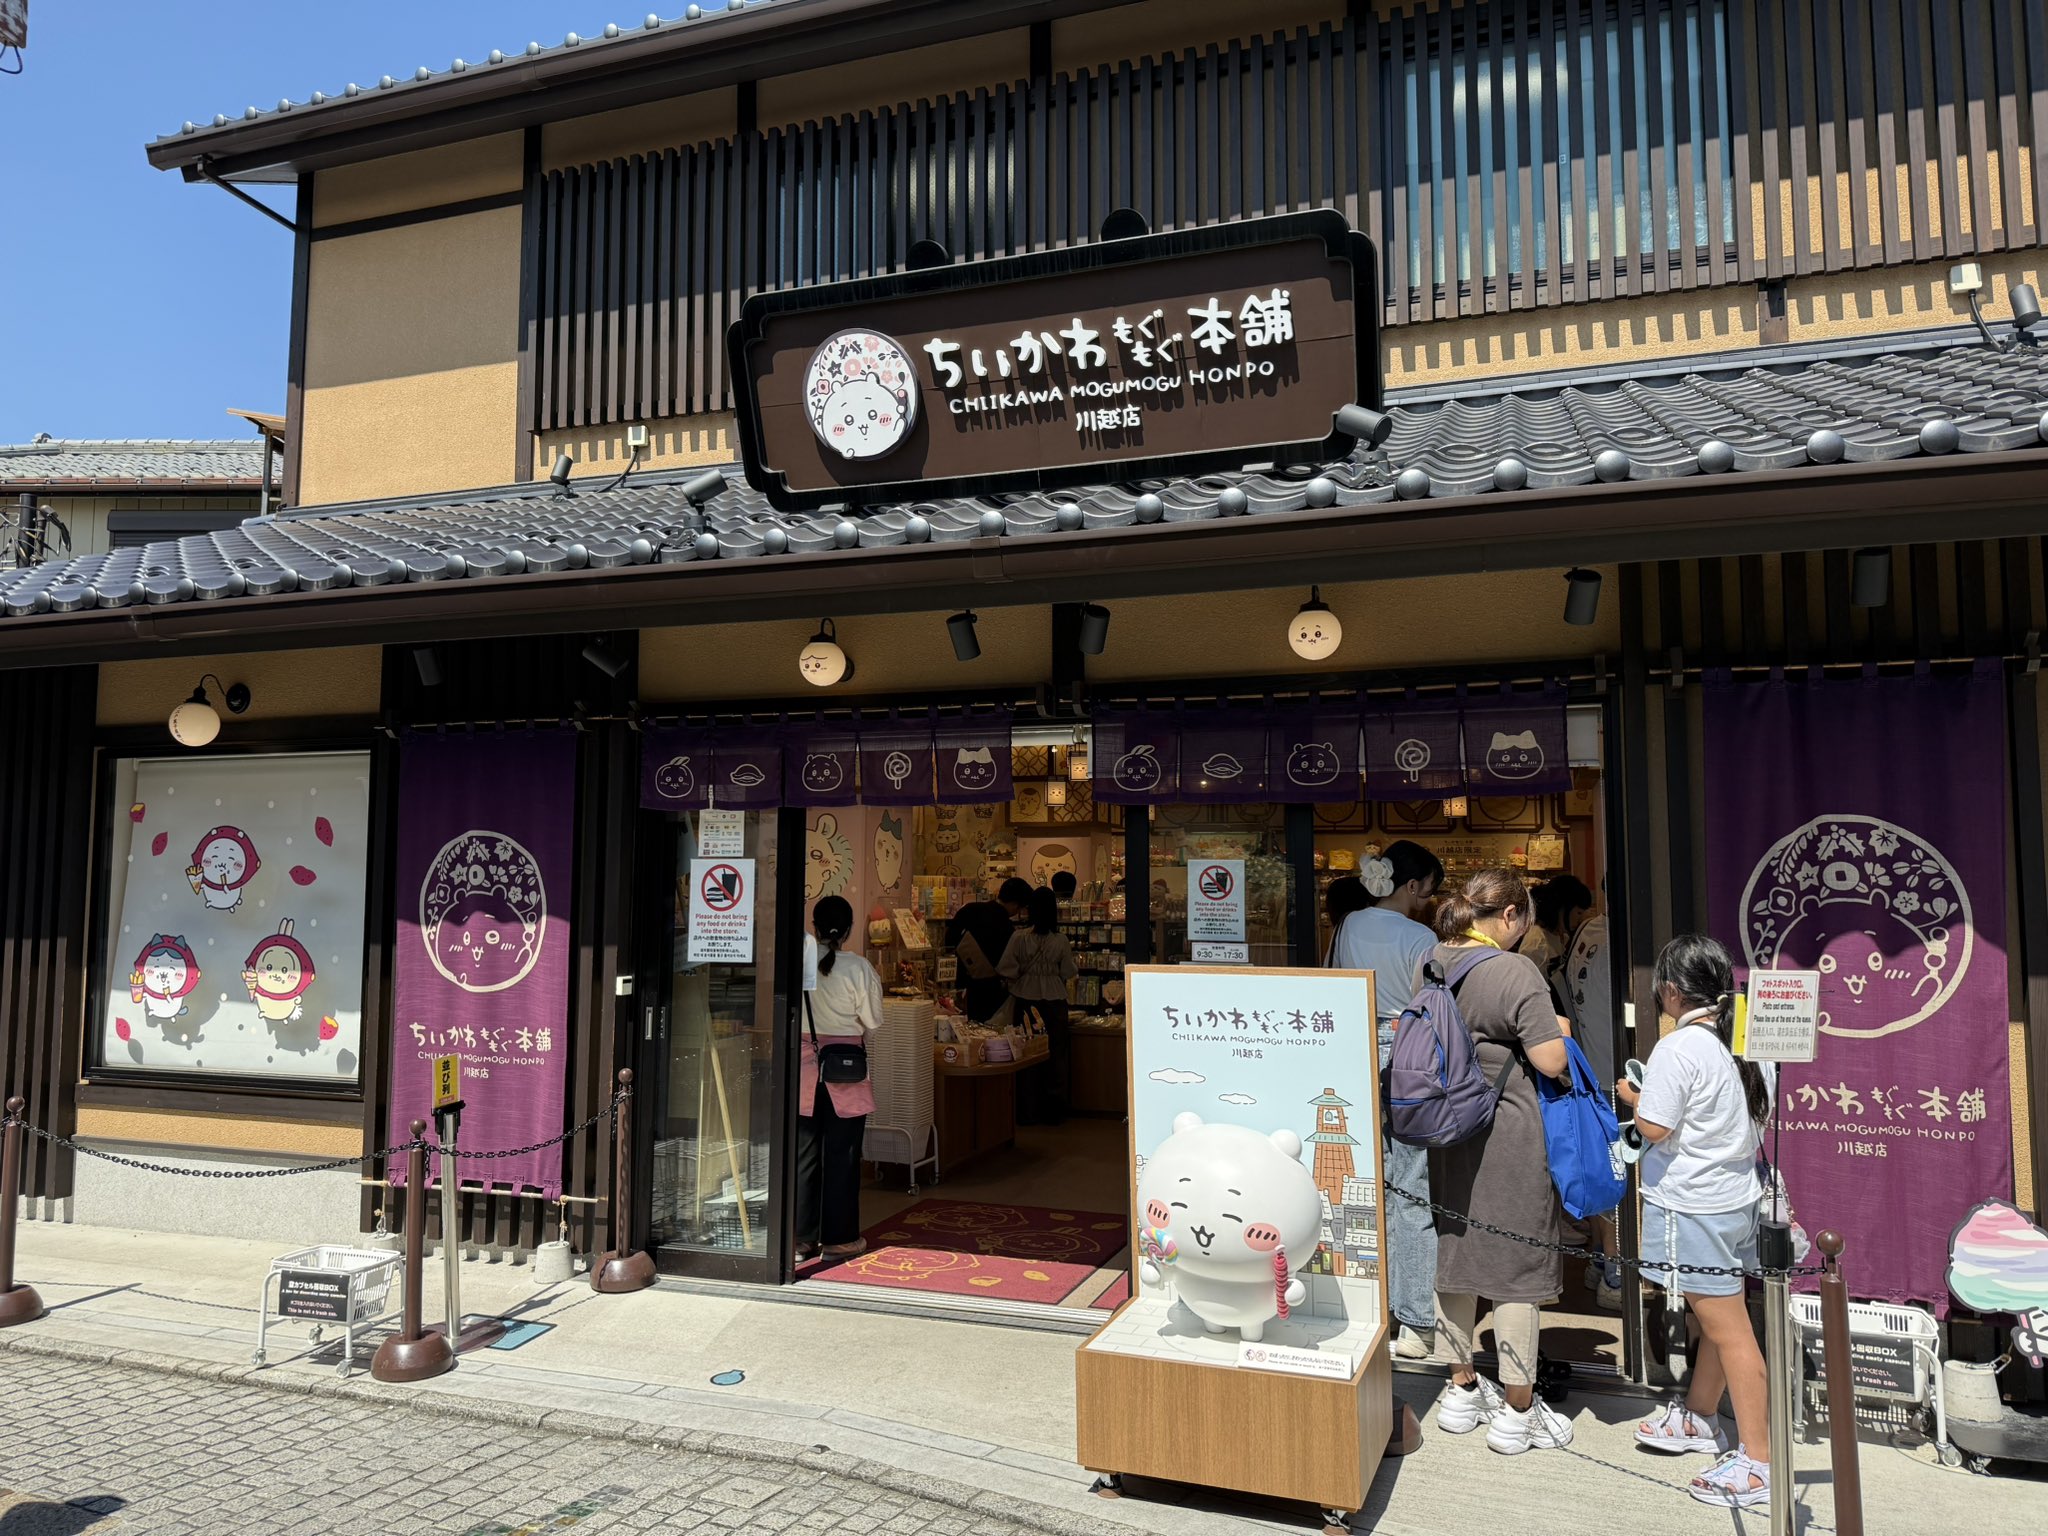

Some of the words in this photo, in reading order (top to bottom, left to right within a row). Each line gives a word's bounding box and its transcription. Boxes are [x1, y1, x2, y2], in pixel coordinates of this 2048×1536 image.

[949, 389, 1063, 414] CHIIKAWA
[1070, 376, 1182, 398] MOGUMOGU
[1189, 361, 1275, 385] HONPO
[1076, 404, 1141, 432] 川越店
[1223, 951, 1244, 959] 17:30
[1172, 1033, 1227, 1042] CHIIKAWA
[1230, 1035, 1283, 1045] MOGUMOGU
[1287, 1038, 1326, 1046] HONPO
[463, 1053, 510, 1065] MOGUMOGU
[513, 1057, 545, 1065] HONPO
[1232, 1048, 1263, 1059] 川越店
[442, 1059, 451, 1095] 並び列
[464, 1067, 489, 1079] 川越店
[1835, 1123, 1911, 1136] MOGUMOGU
[1917, 1127, 1975, 1141] HONPO
[1838, 1141, 1888, 1157] 川越店
[1862, 1376, 1882, 1384] trash
